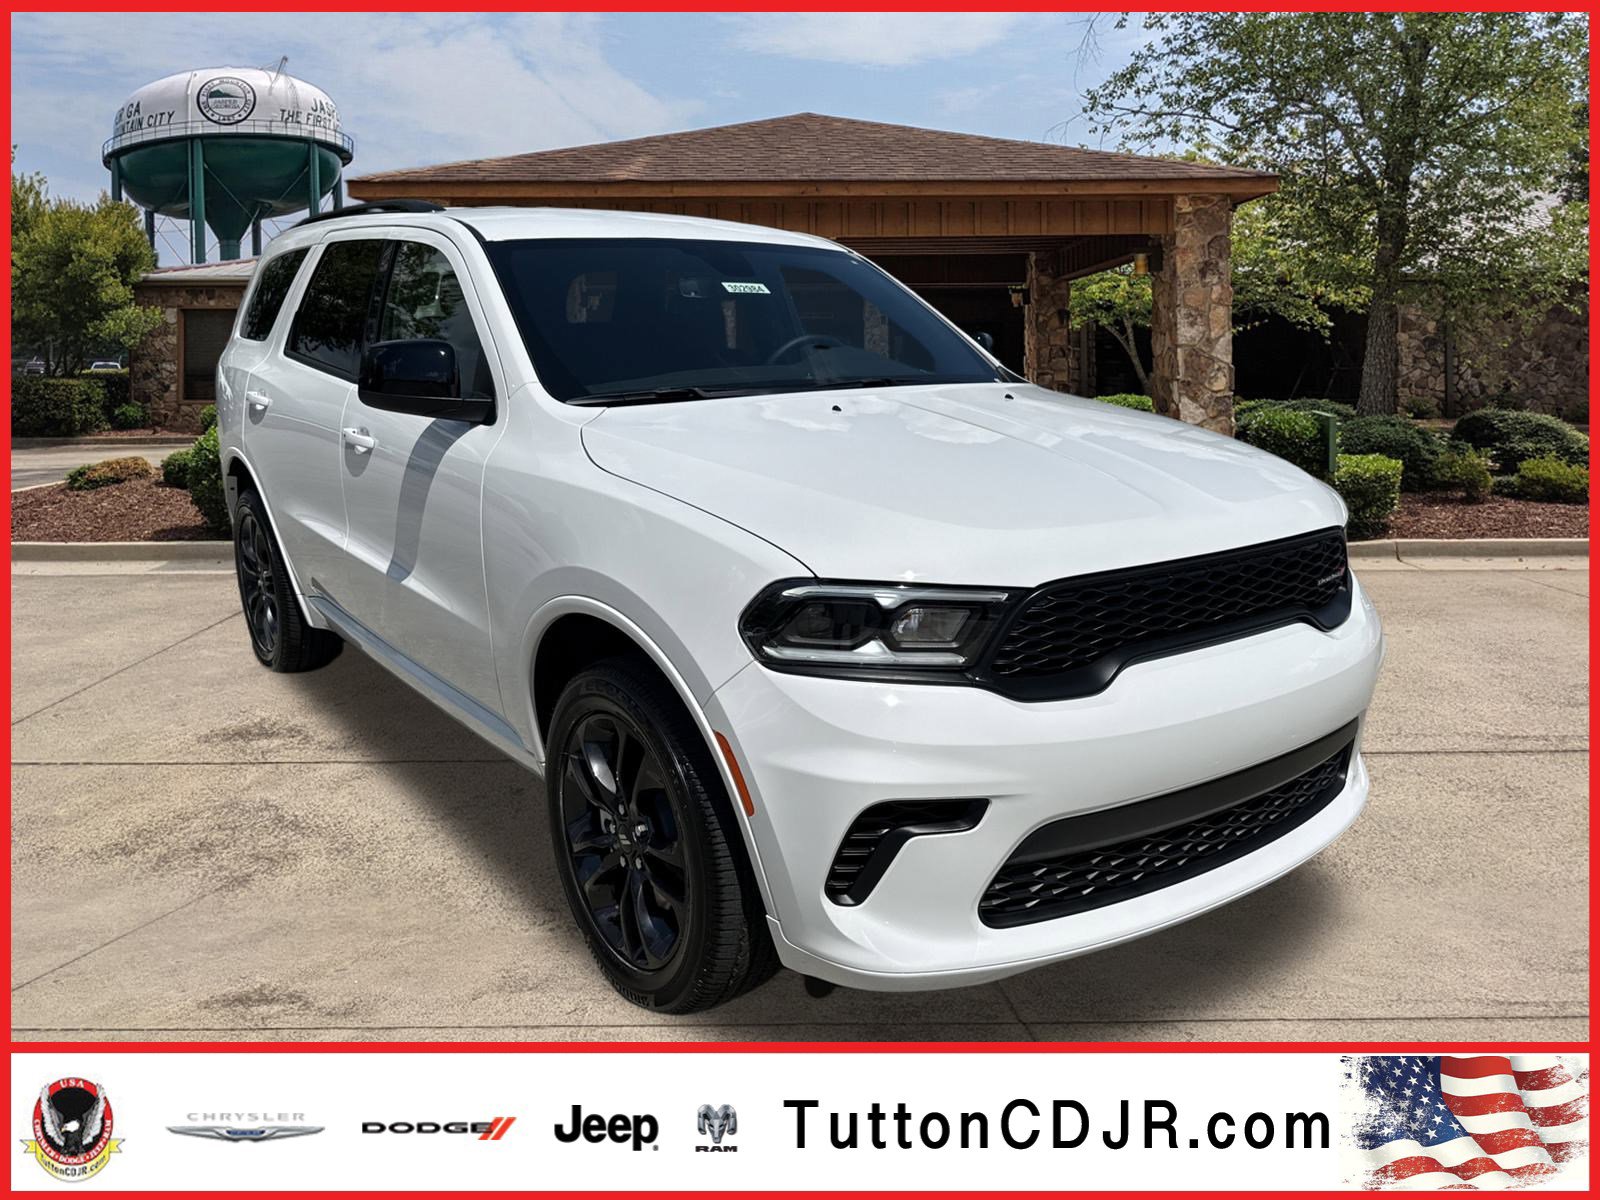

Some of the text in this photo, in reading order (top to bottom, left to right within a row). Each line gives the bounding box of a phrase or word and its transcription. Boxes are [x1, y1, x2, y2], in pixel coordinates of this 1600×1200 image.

[126, 101, 141, 118] GA
[147, 110, 175, 127] CITY
[280, 108, 302, 125] THE
[306, 112, 331, 130] FIRST
